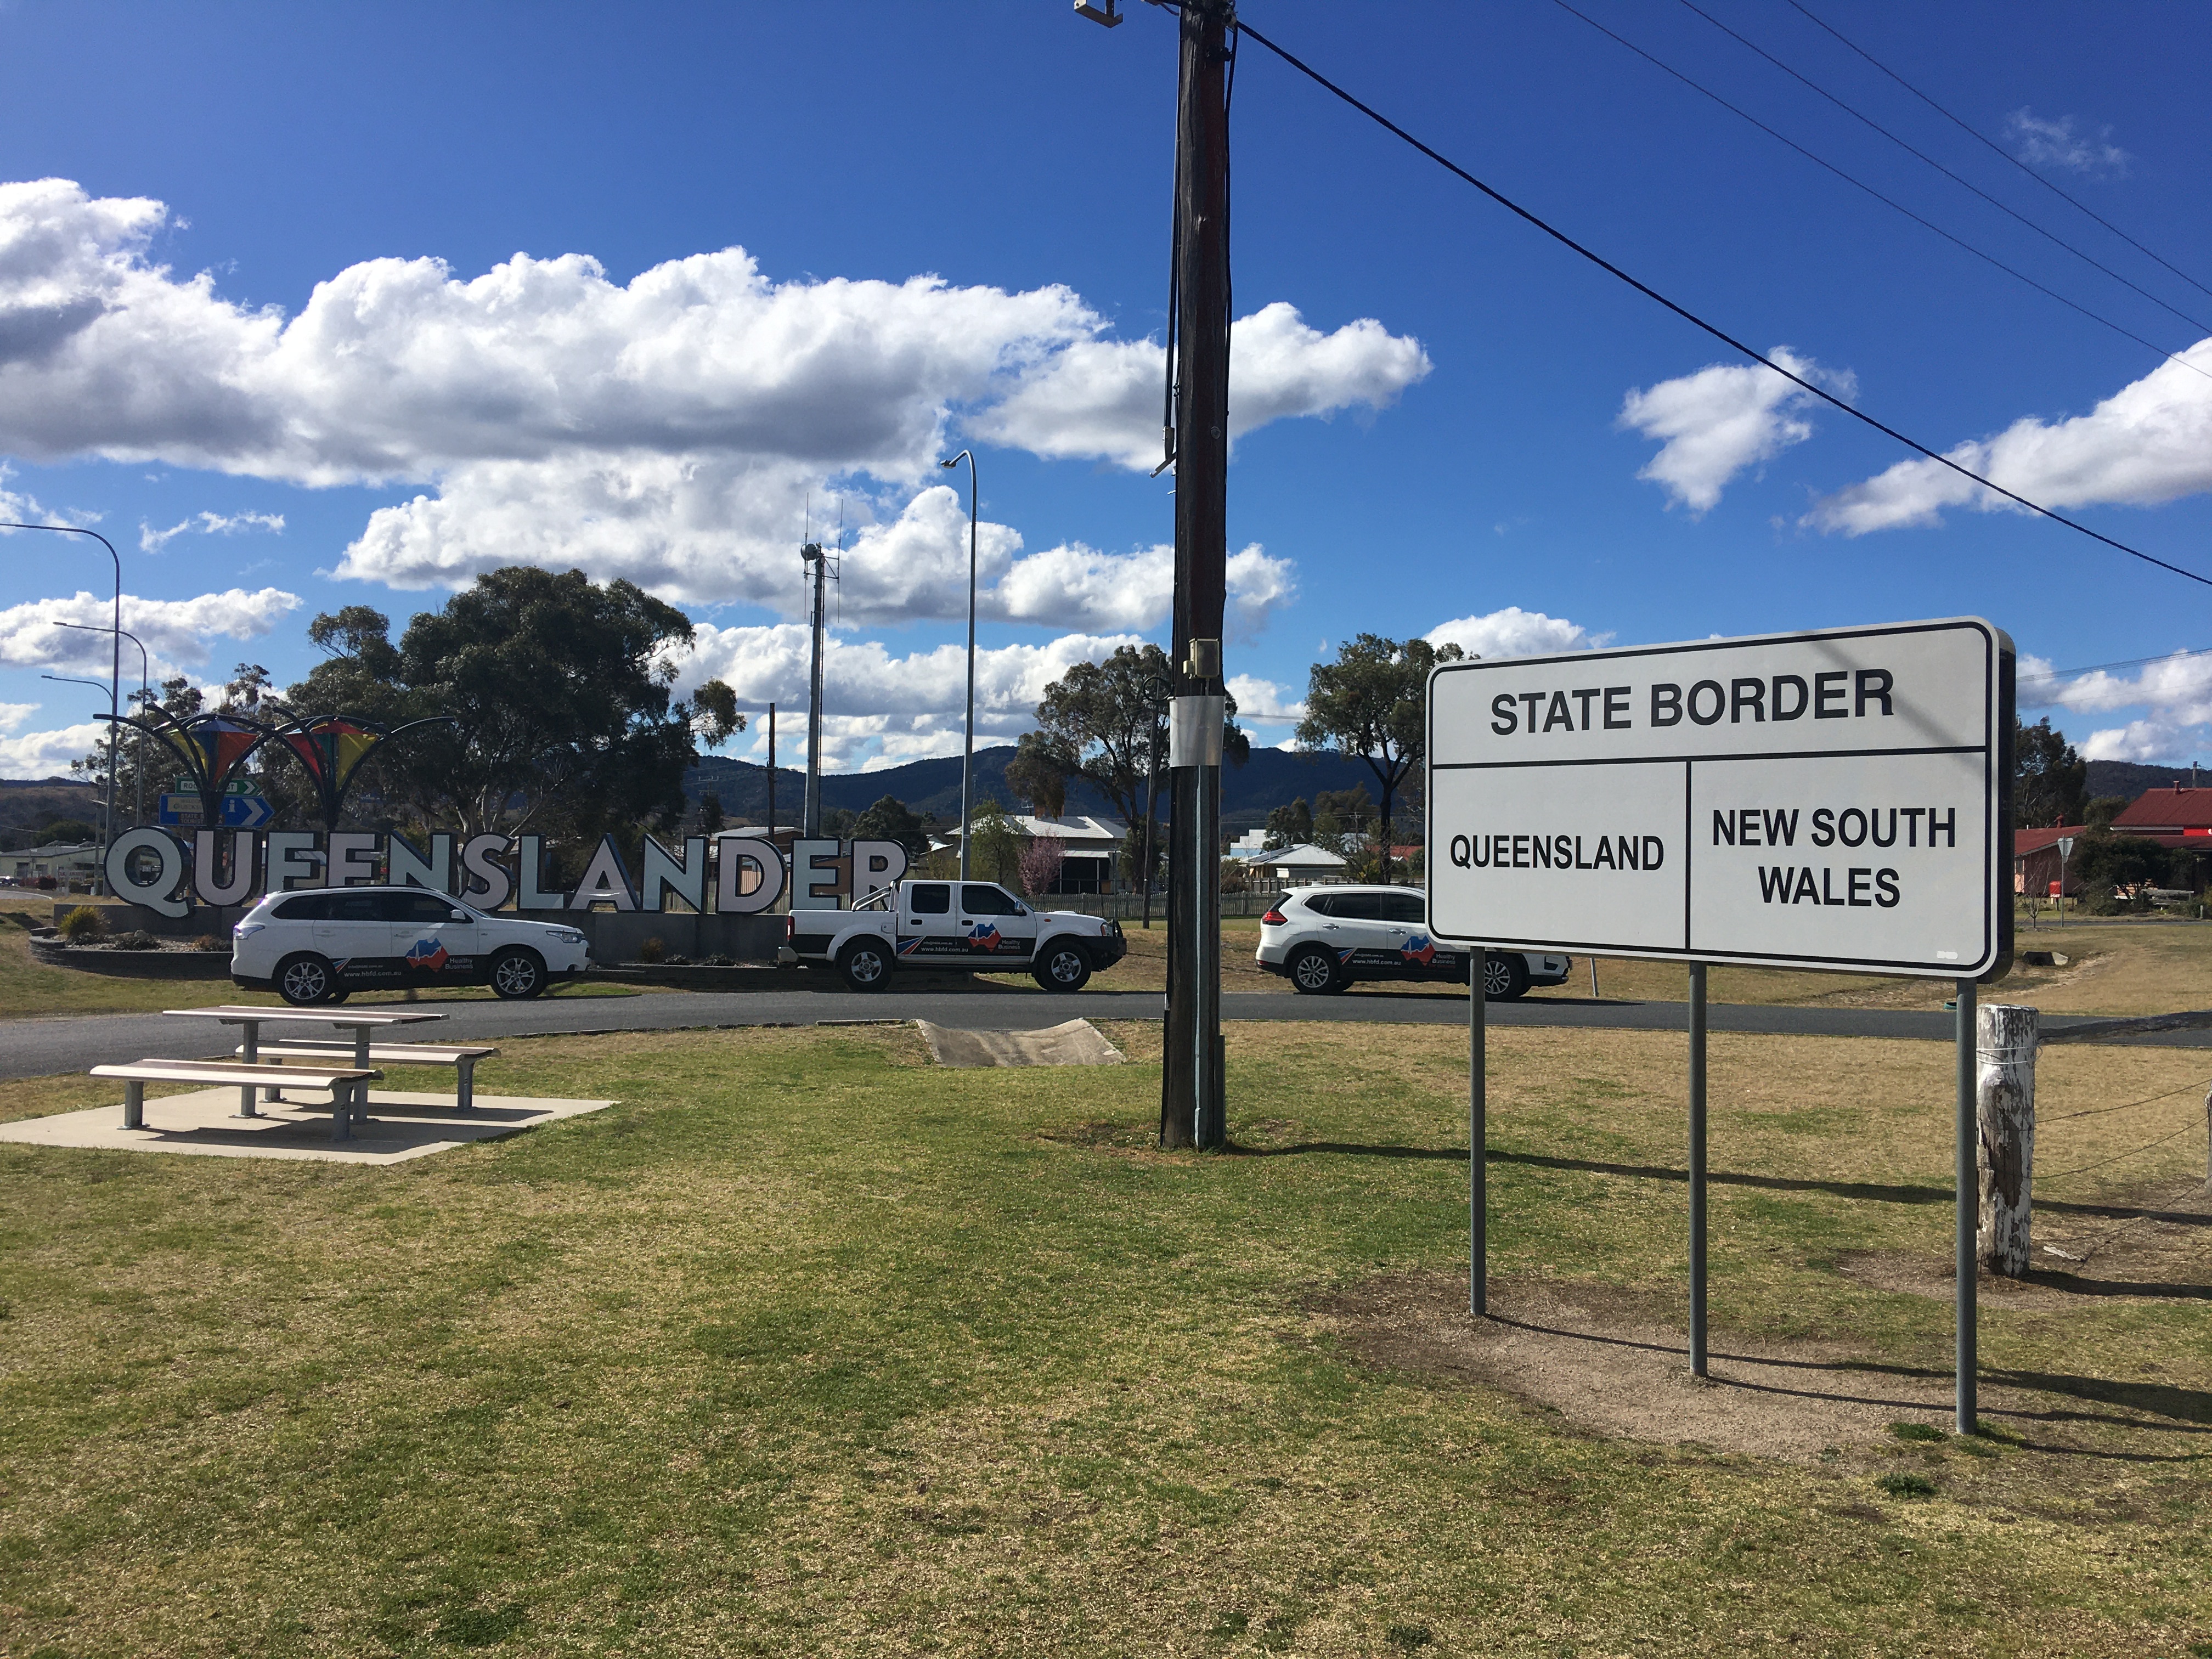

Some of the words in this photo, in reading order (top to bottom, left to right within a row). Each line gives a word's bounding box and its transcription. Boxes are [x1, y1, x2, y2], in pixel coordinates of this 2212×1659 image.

[1491, 686, 1632, 736] STATE
[1650, 668, 1894, 727] BORDER
[1713, 809, 1799, 847] NEW
[1810, 808, 1955, 848] SOUTH
[105, 825, 909, 918] QUEENSLANDER
[1450, 834, 1664, 871] QUEENSLAND
[1758, 866, 1900, 908] WALES
